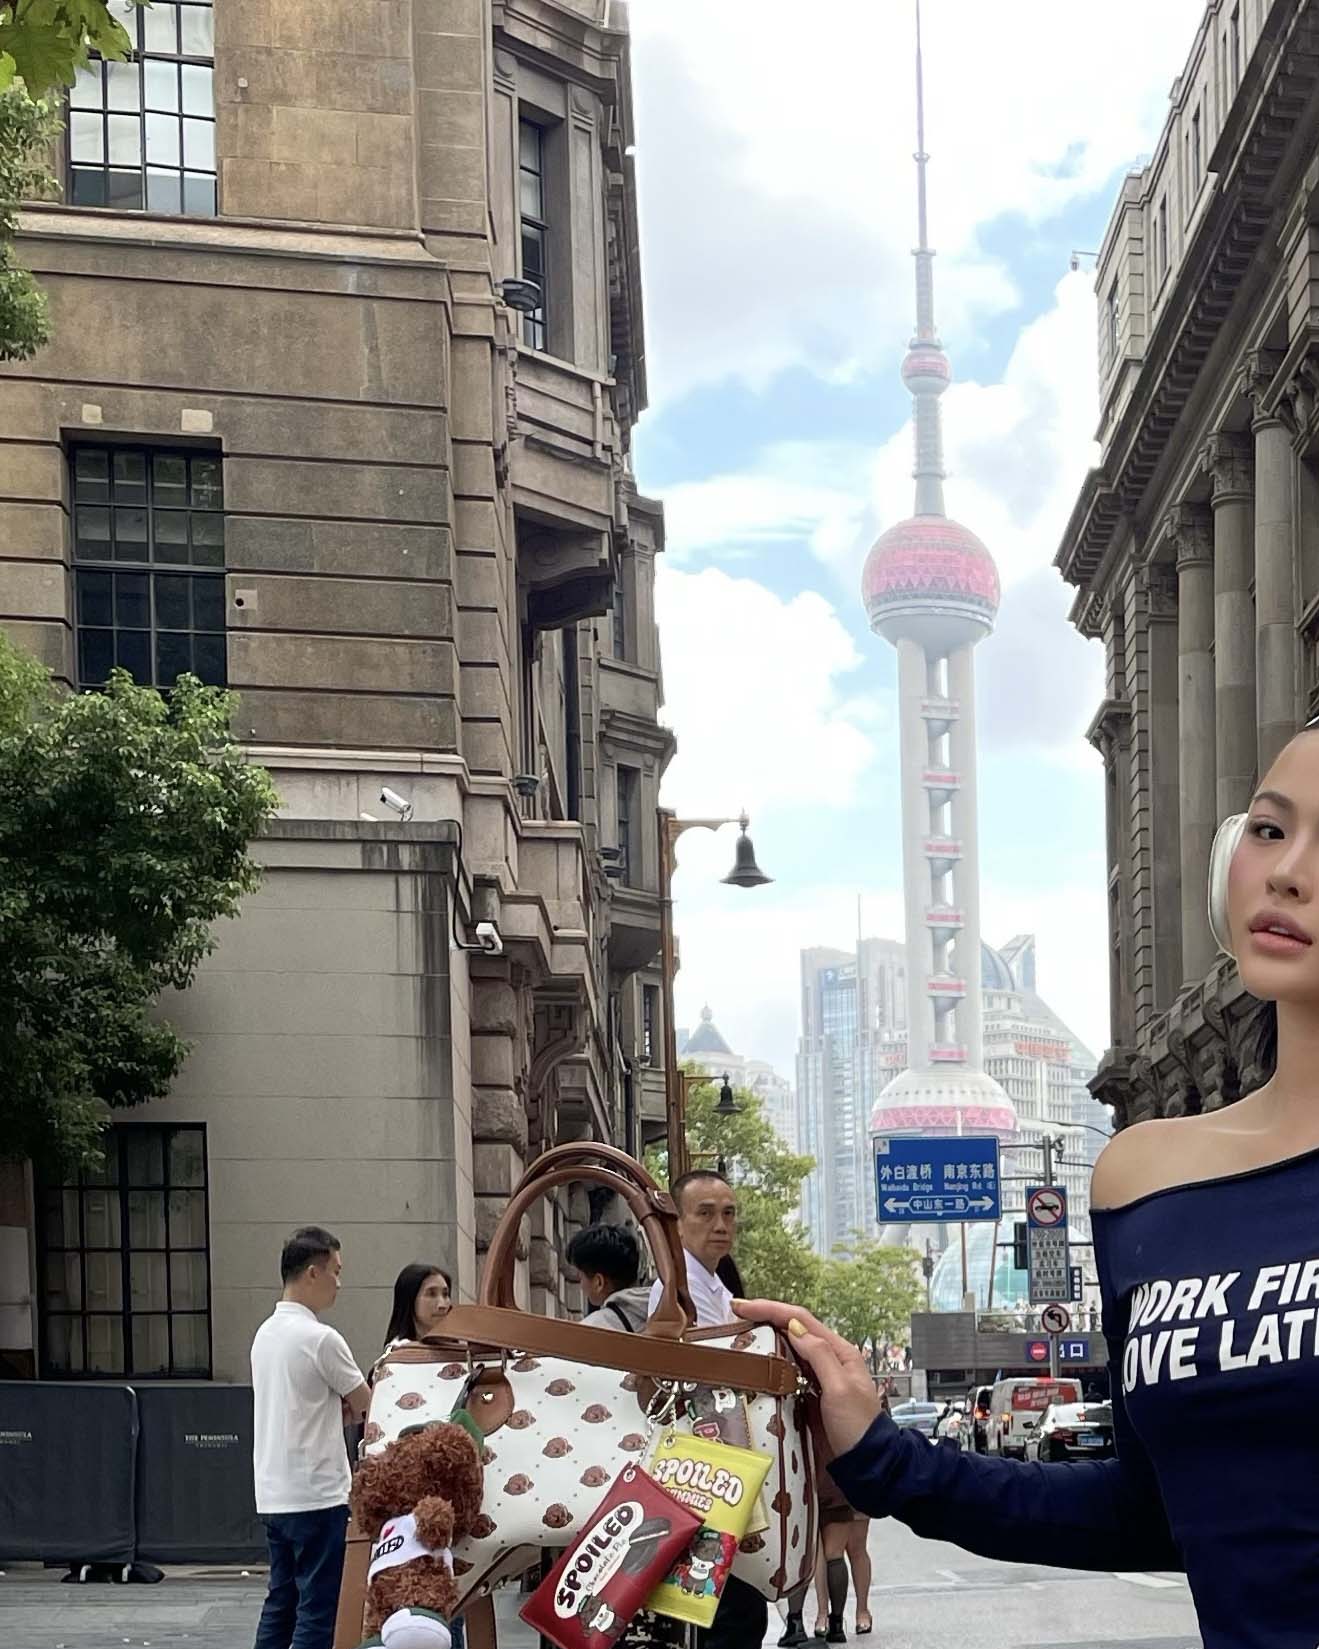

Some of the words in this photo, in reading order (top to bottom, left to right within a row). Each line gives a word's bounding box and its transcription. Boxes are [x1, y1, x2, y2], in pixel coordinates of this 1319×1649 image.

[880, 1163, 932, 1180] 外白渡桥
[943, 1163, 995, 1179] 南京东路
[912, 1198, 965, 1210] 中山东一路
[1122, 1326, 1200, 1397] OVE
[653, 1457, 744, 1507] SPOILED
[557, 1505, 634, 1609] SPOILED
